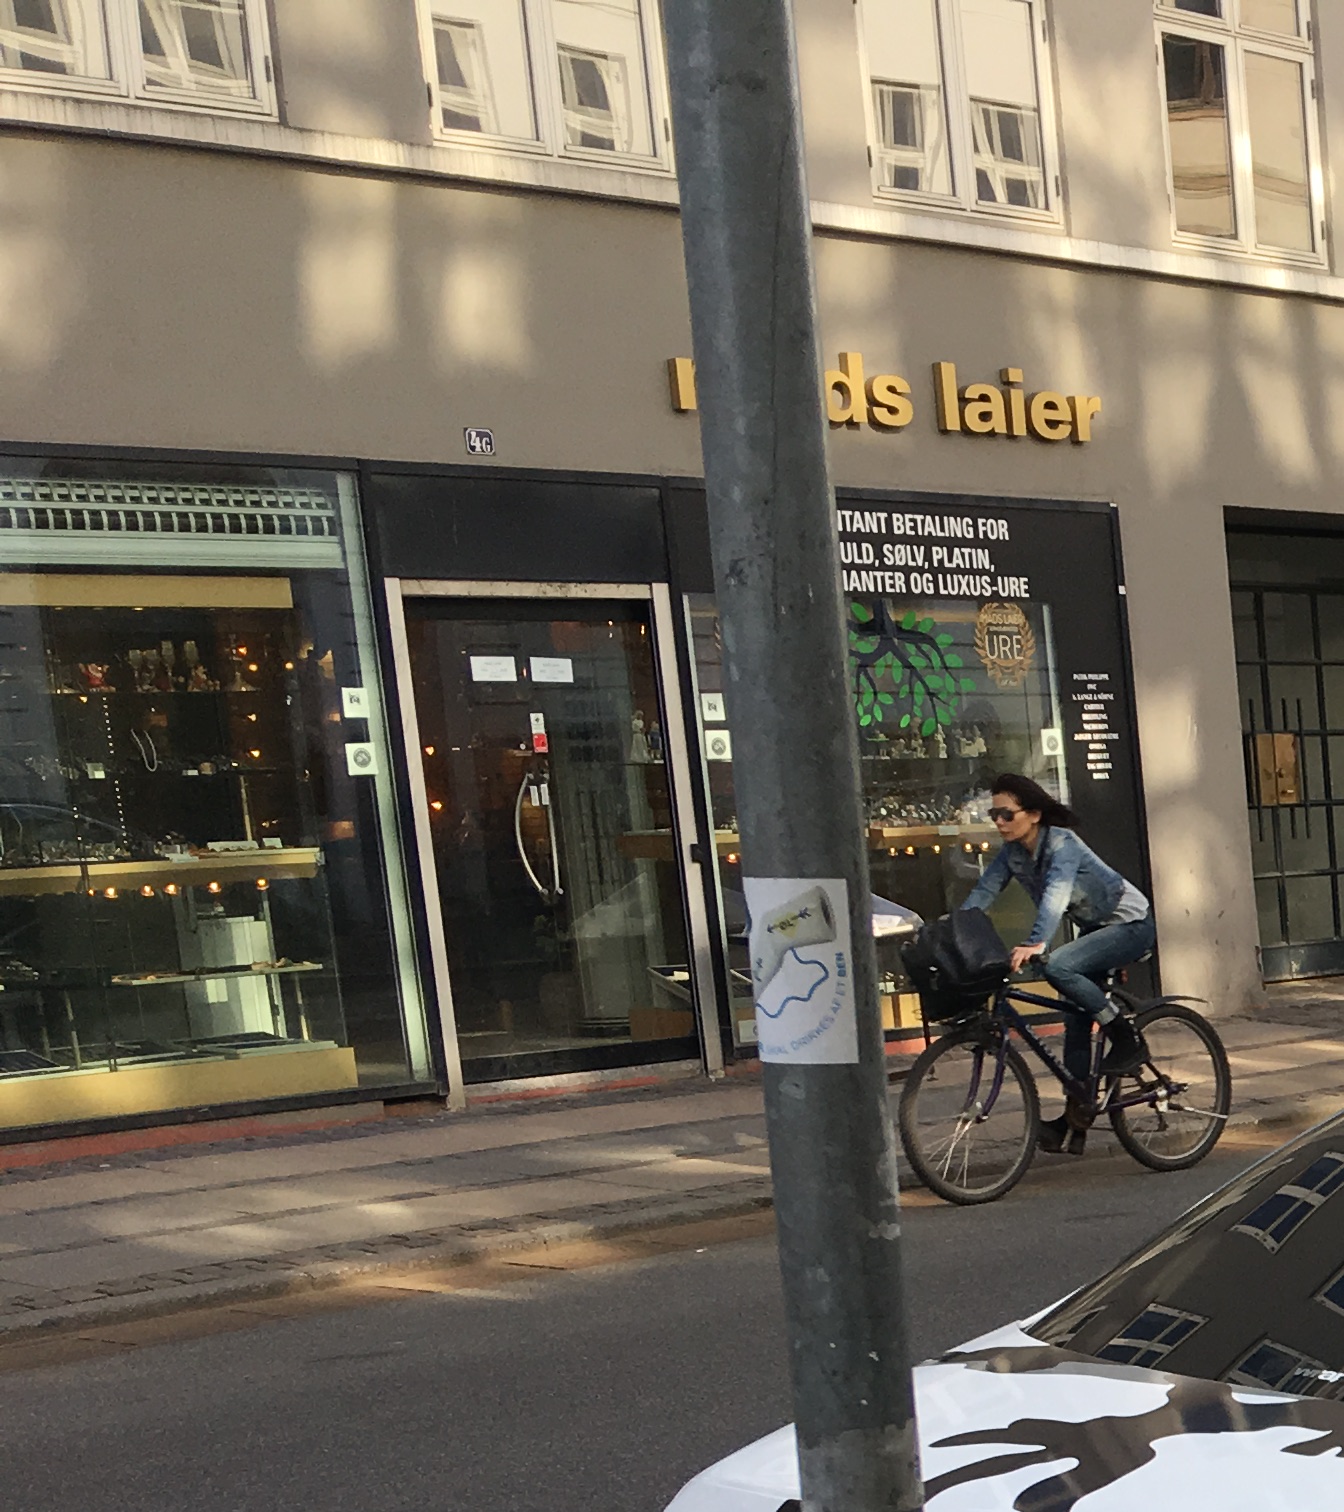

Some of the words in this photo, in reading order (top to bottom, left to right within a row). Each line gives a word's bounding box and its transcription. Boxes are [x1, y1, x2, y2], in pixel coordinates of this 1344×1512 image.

[932, 361, 1102, 442] laier
[470, 431, 491, 453] 4G
[837, 509, 887, 534] TANT
[892, 513, 974, 539] BETALING
[977, 518, 1009, 540] FOR
[840, 541, 879, 567] ULD,
[883, 544, 929, 569] SØLV,
[931, 546, 995, 572] PLATIN,
[842, 569, 905, 593] IANTER
[910, 574, 935, 594] OG
[938, 574, 1030, 598] LUXUS-URE
[985, 634, 1024, 659] URE
